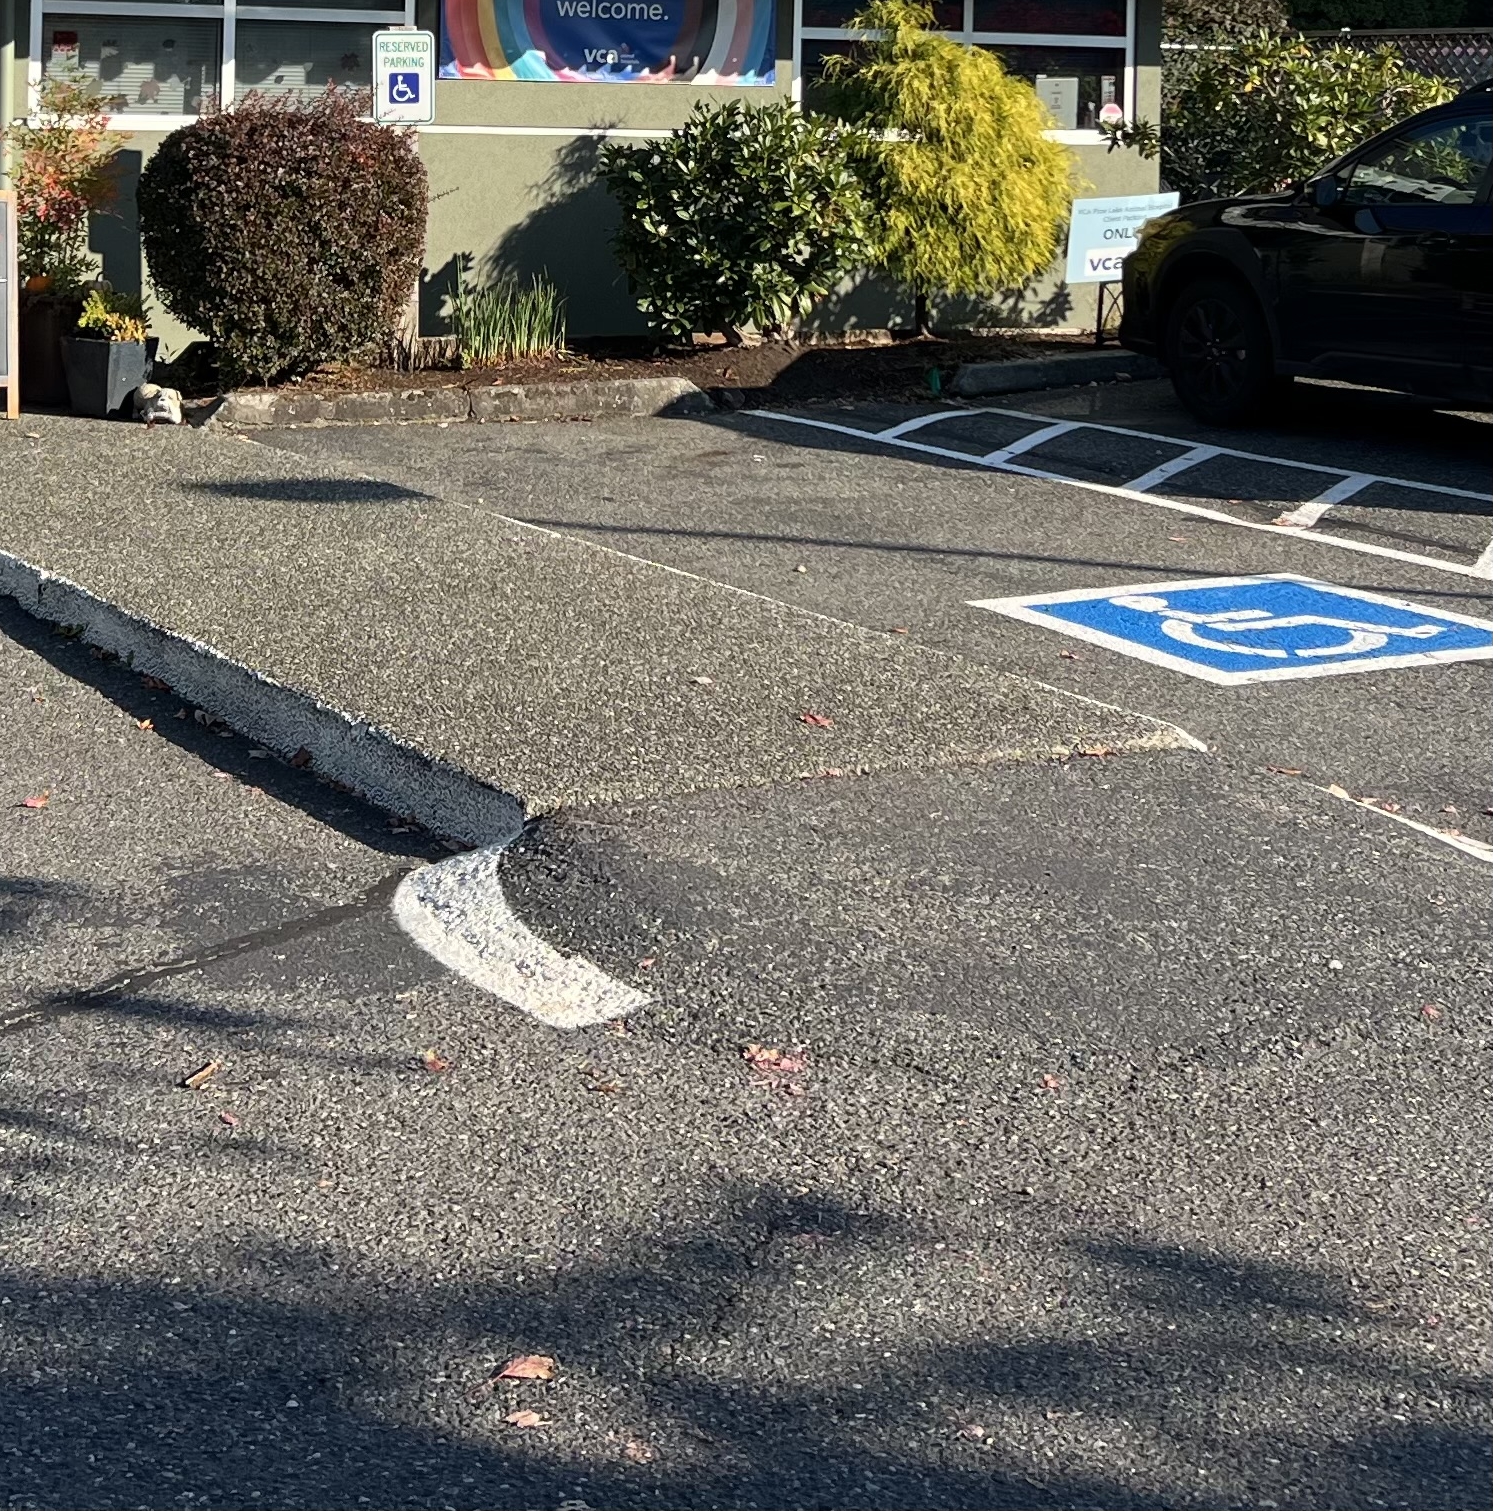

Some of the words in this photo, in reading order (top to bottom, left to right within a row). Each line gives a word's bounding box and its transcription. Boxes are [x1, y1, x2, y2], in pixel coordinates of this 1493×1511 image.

[379, 41, 429, 53] RESERVED
[383, 57, 425, 68] PARKING
[583, 47, 620, 65] vca
[1089, 256, 1123, 271] vca
